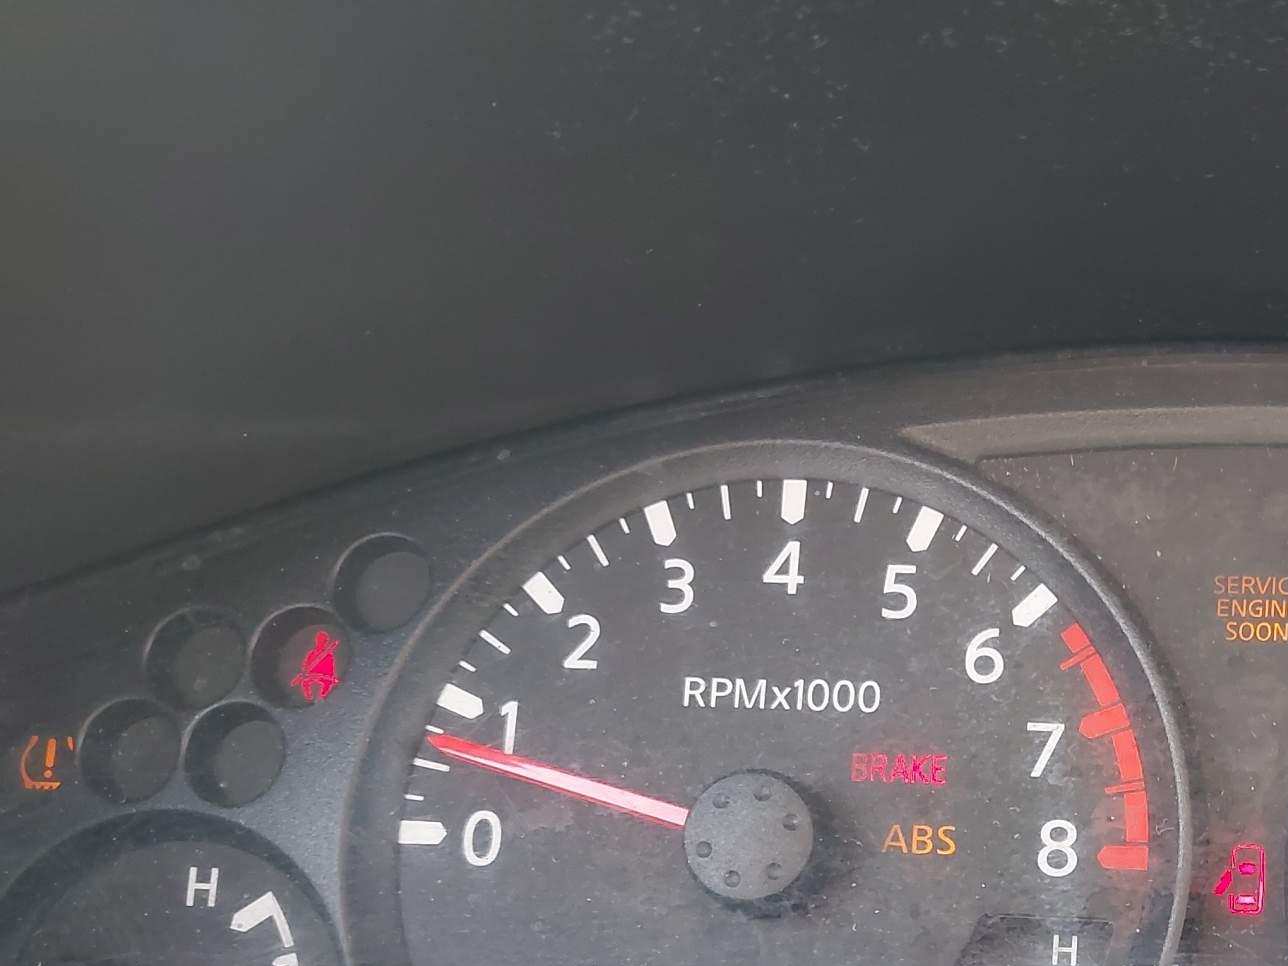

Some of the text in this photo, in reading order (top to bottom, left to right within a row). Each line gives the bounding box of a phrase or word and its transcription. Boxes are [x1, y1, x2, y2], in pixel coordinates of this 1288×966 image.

[660, 559, 694, 613] 3
[763, 541, 804, 594] 4
[882, 565, 917, 619] 5
[564, 615, 600, 669] 2
[966, 628, 1003, 683] 6
[1225, 621, 1288, 641] SOON
[684, 677, 880, 712] RPMx1000
[500, 701, 519, 755] 1
[1027, 723, 1064, 777] 7
[852, 753, 947, 784] BRAKE
[463, 811, 501, 866] 0
[883, 823, 957, 856] ABS
[1038, 820, 1077, 876] 8
[187, 867, 218, 906] H
[1052, 935, 1077, 966] H
